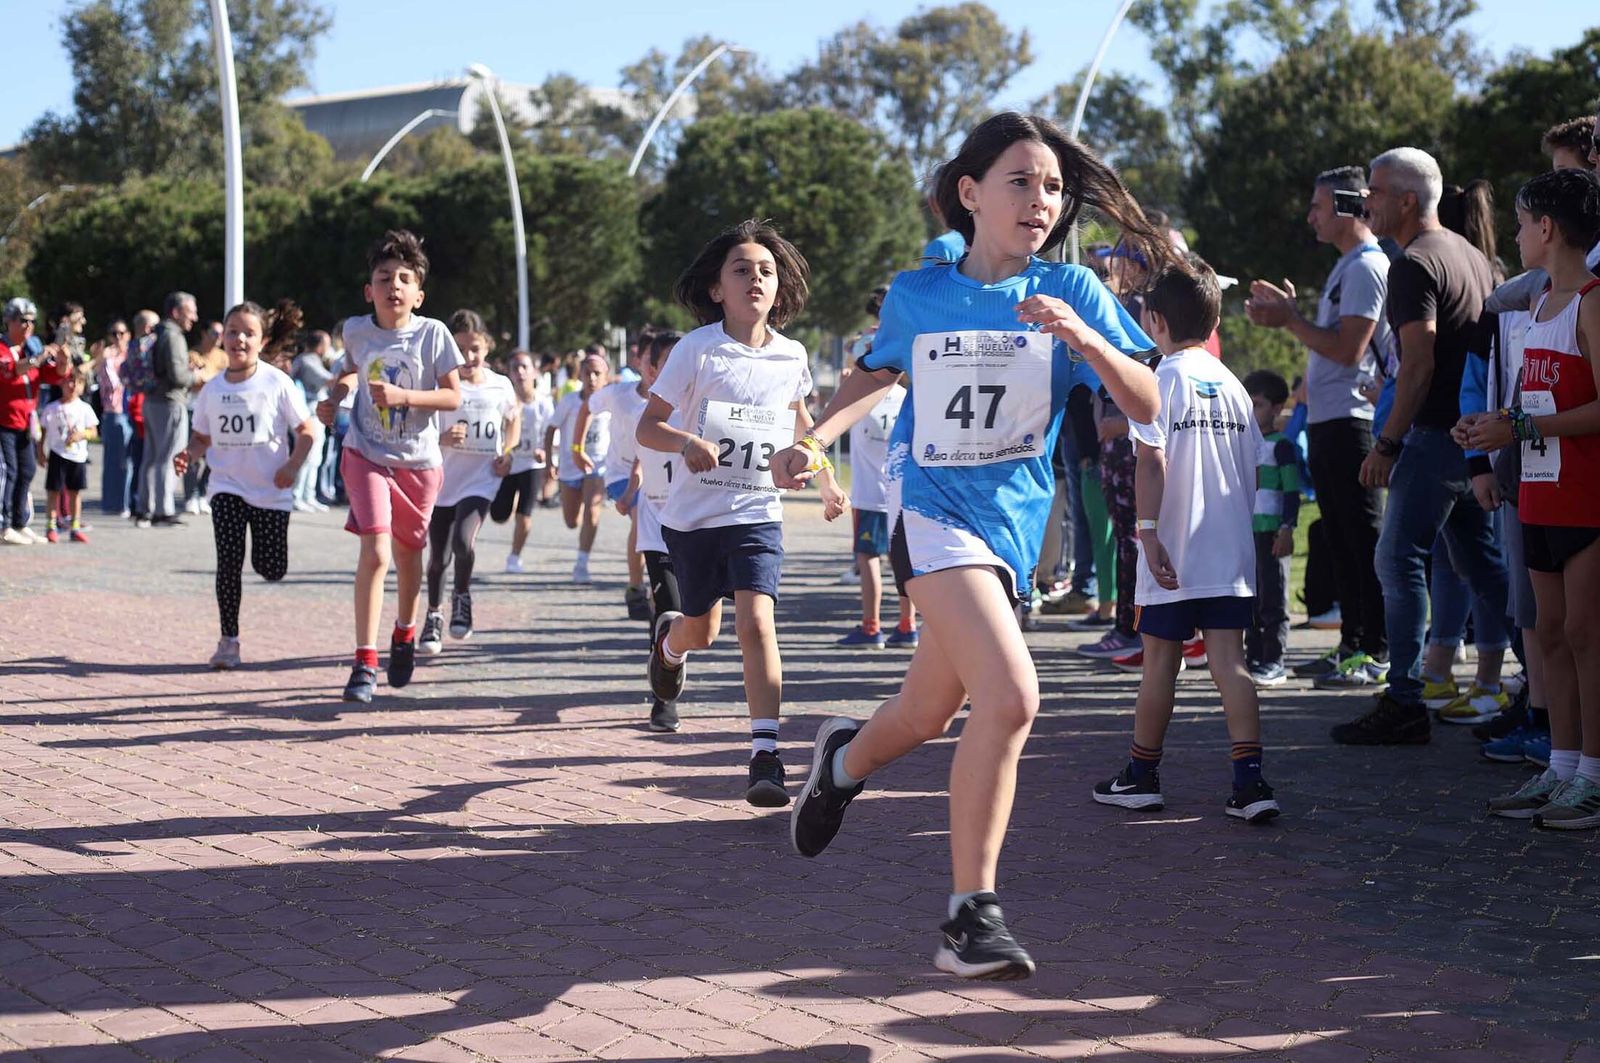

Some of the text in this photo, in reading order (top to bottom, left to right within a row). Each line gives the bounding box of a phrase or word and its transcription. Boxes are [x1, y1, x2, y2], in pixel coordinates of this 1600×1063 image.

[977, 343, 1016, 351] HUELVA
[944, 385, 1007, 429] 47
[218, 414, 256, 434] 201
[717, 438, 775, 472] 213
[979, 452, 994, 460] tus
[994, 443, 1036, 458] sentidos.
[700, 477, 723, 487] Huelva
[741, 483, 753, 491] tus
